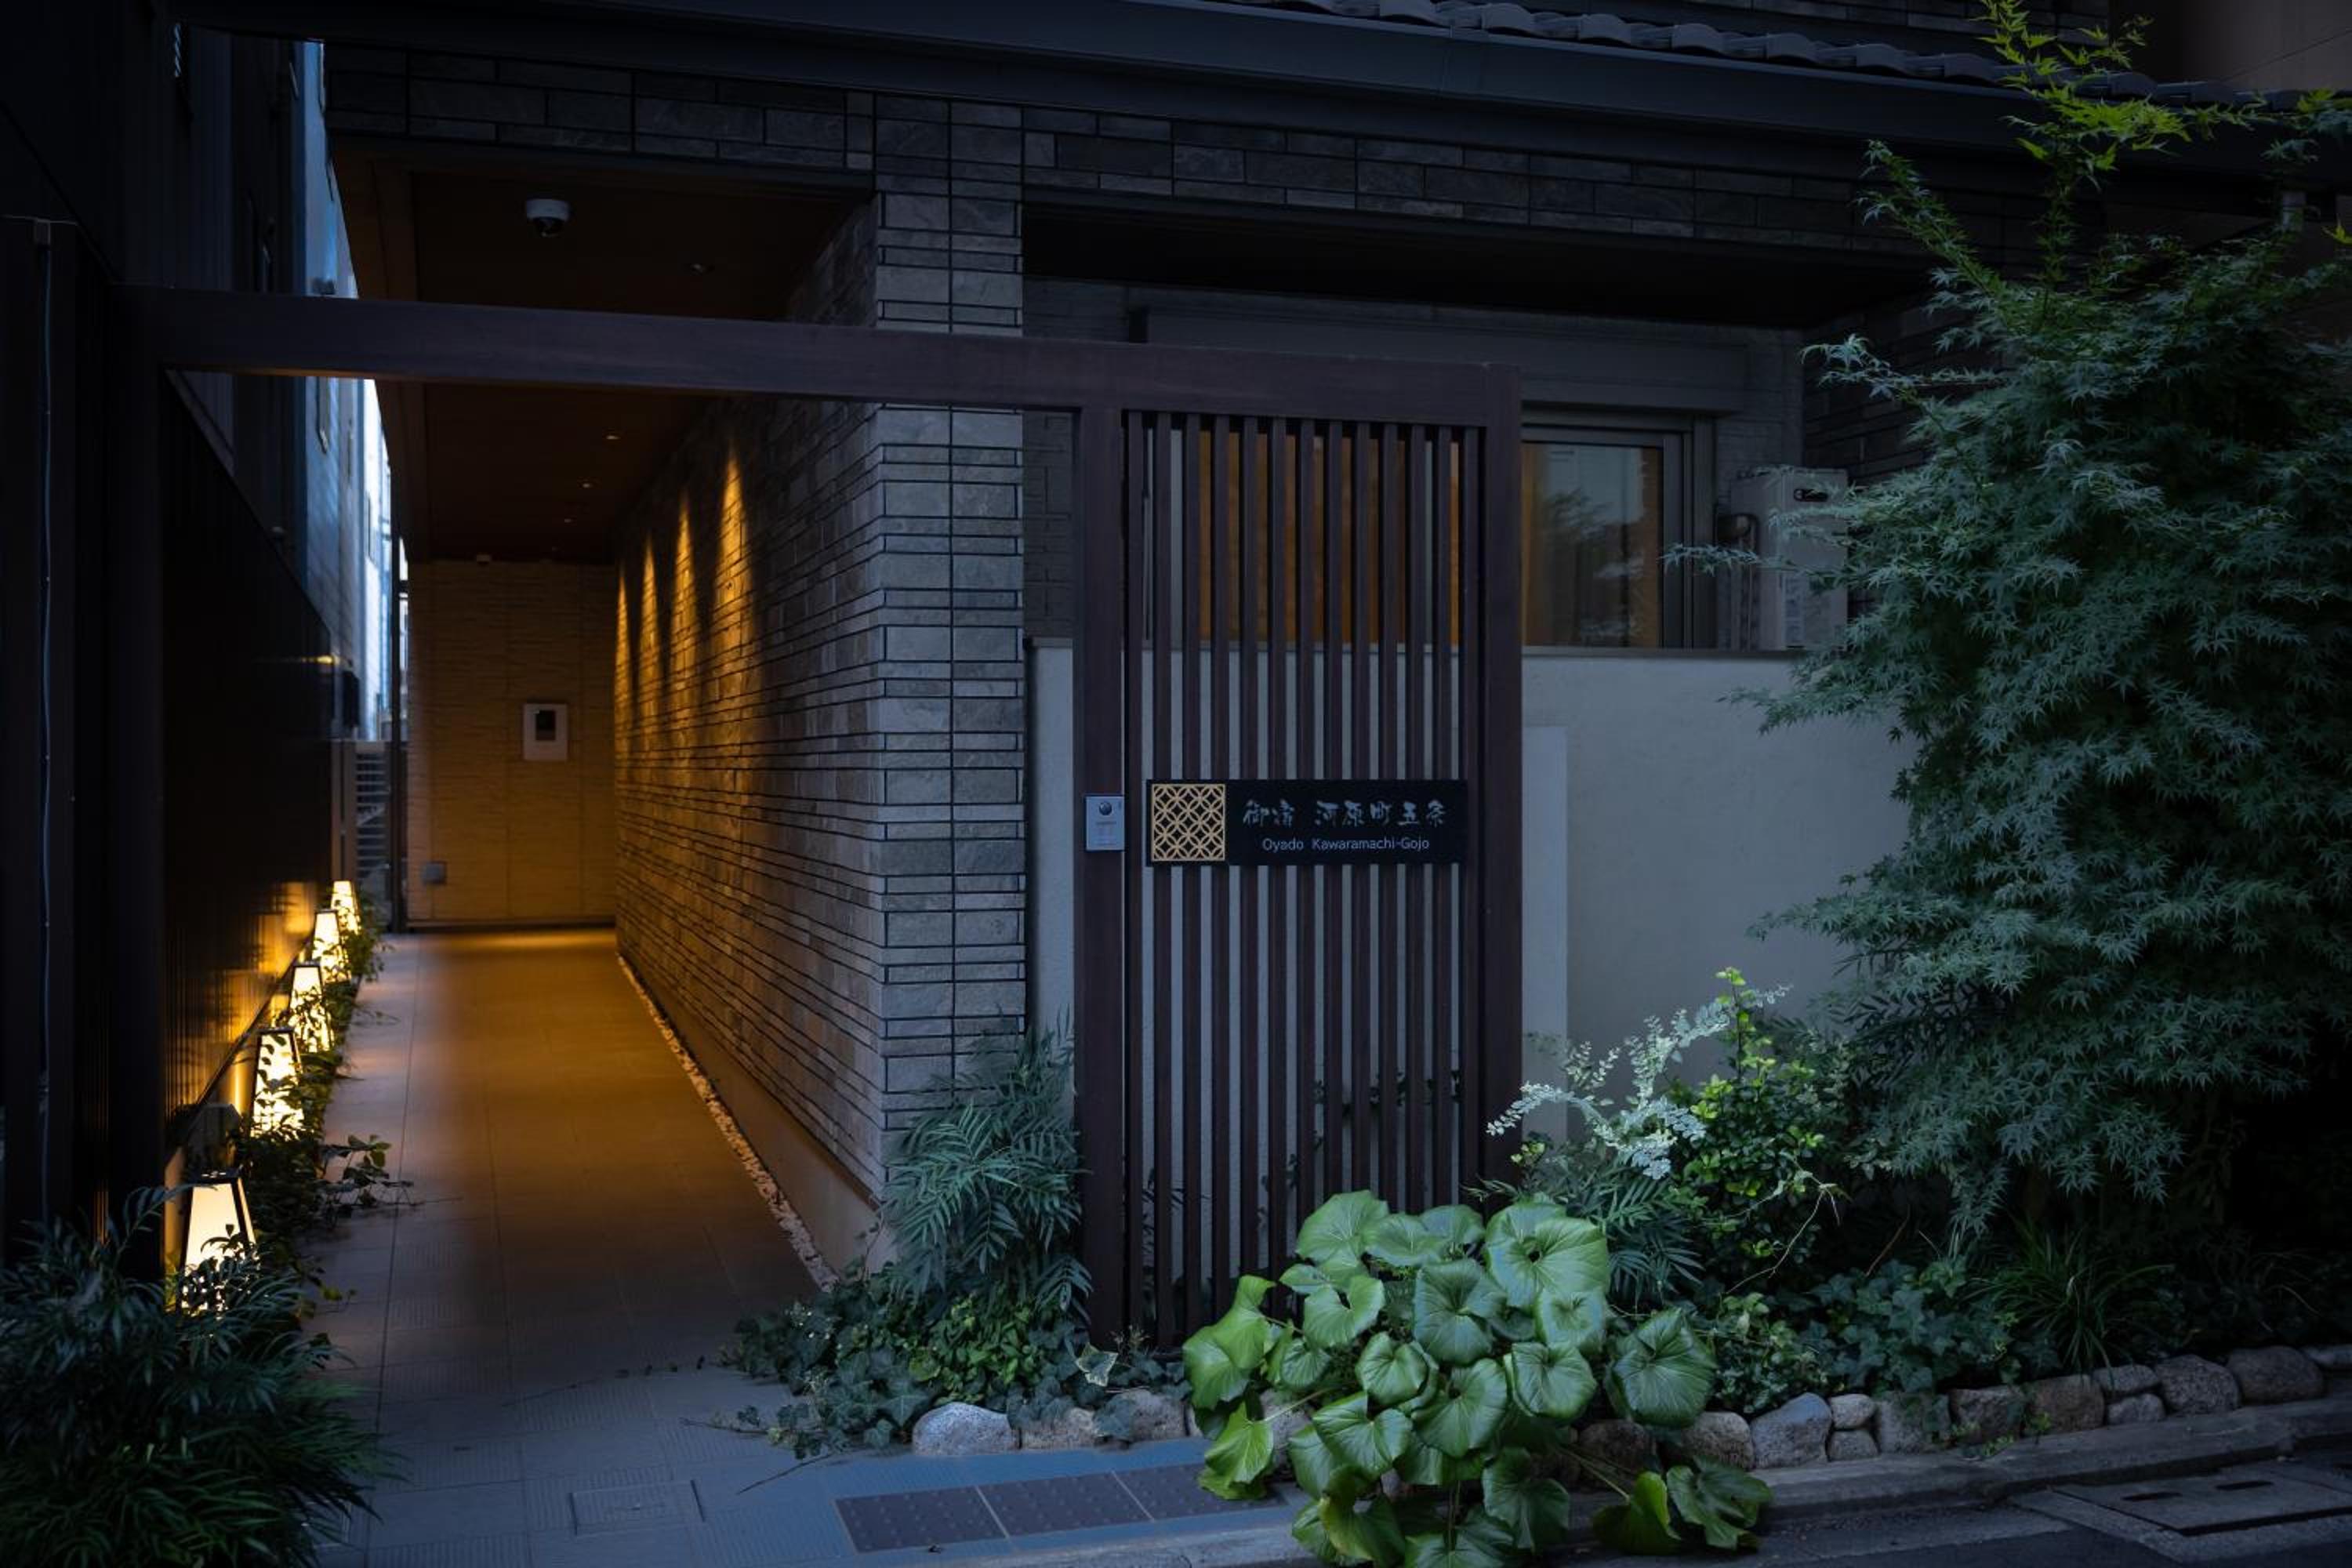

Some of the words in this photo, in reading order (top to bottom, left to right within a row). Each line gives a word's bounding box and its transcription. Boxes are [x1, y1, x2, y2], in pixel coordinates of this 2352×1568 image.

[1314, 800, 1446, 827] 河原町五条
[1262, 837, 1305, 853] Oyado
[1312, 836, 1430, 852] Kawaramachi-Gojo
